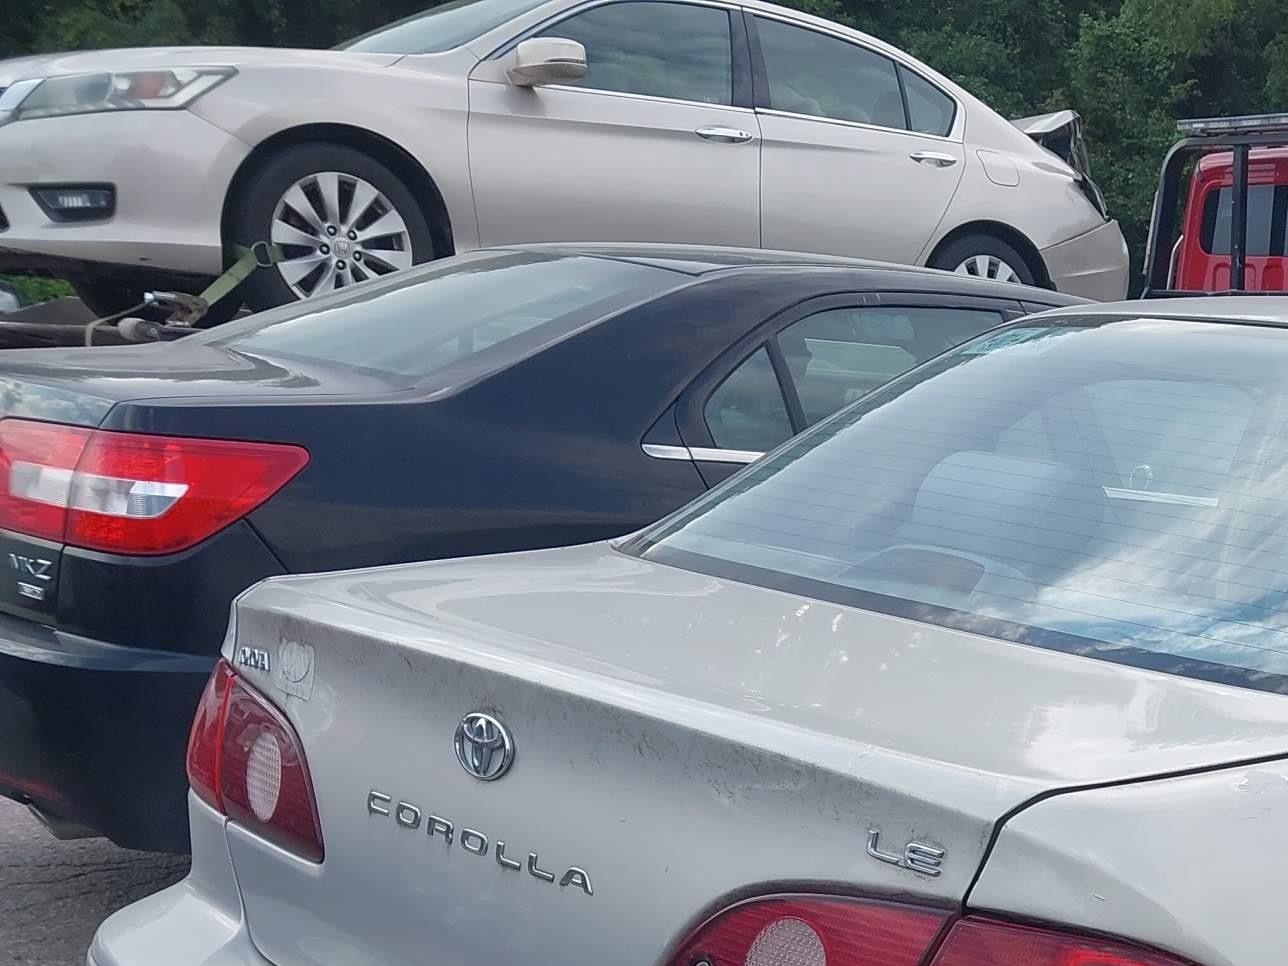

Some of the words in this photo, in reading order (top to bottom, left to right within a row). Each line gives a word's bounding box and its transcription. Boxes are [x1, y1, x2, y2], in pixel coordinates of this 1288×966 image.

[8, 552, 52, 580] MKZ
[367, 788, 594, 896] COROLLA
[867, 828, 945, 877] LE
